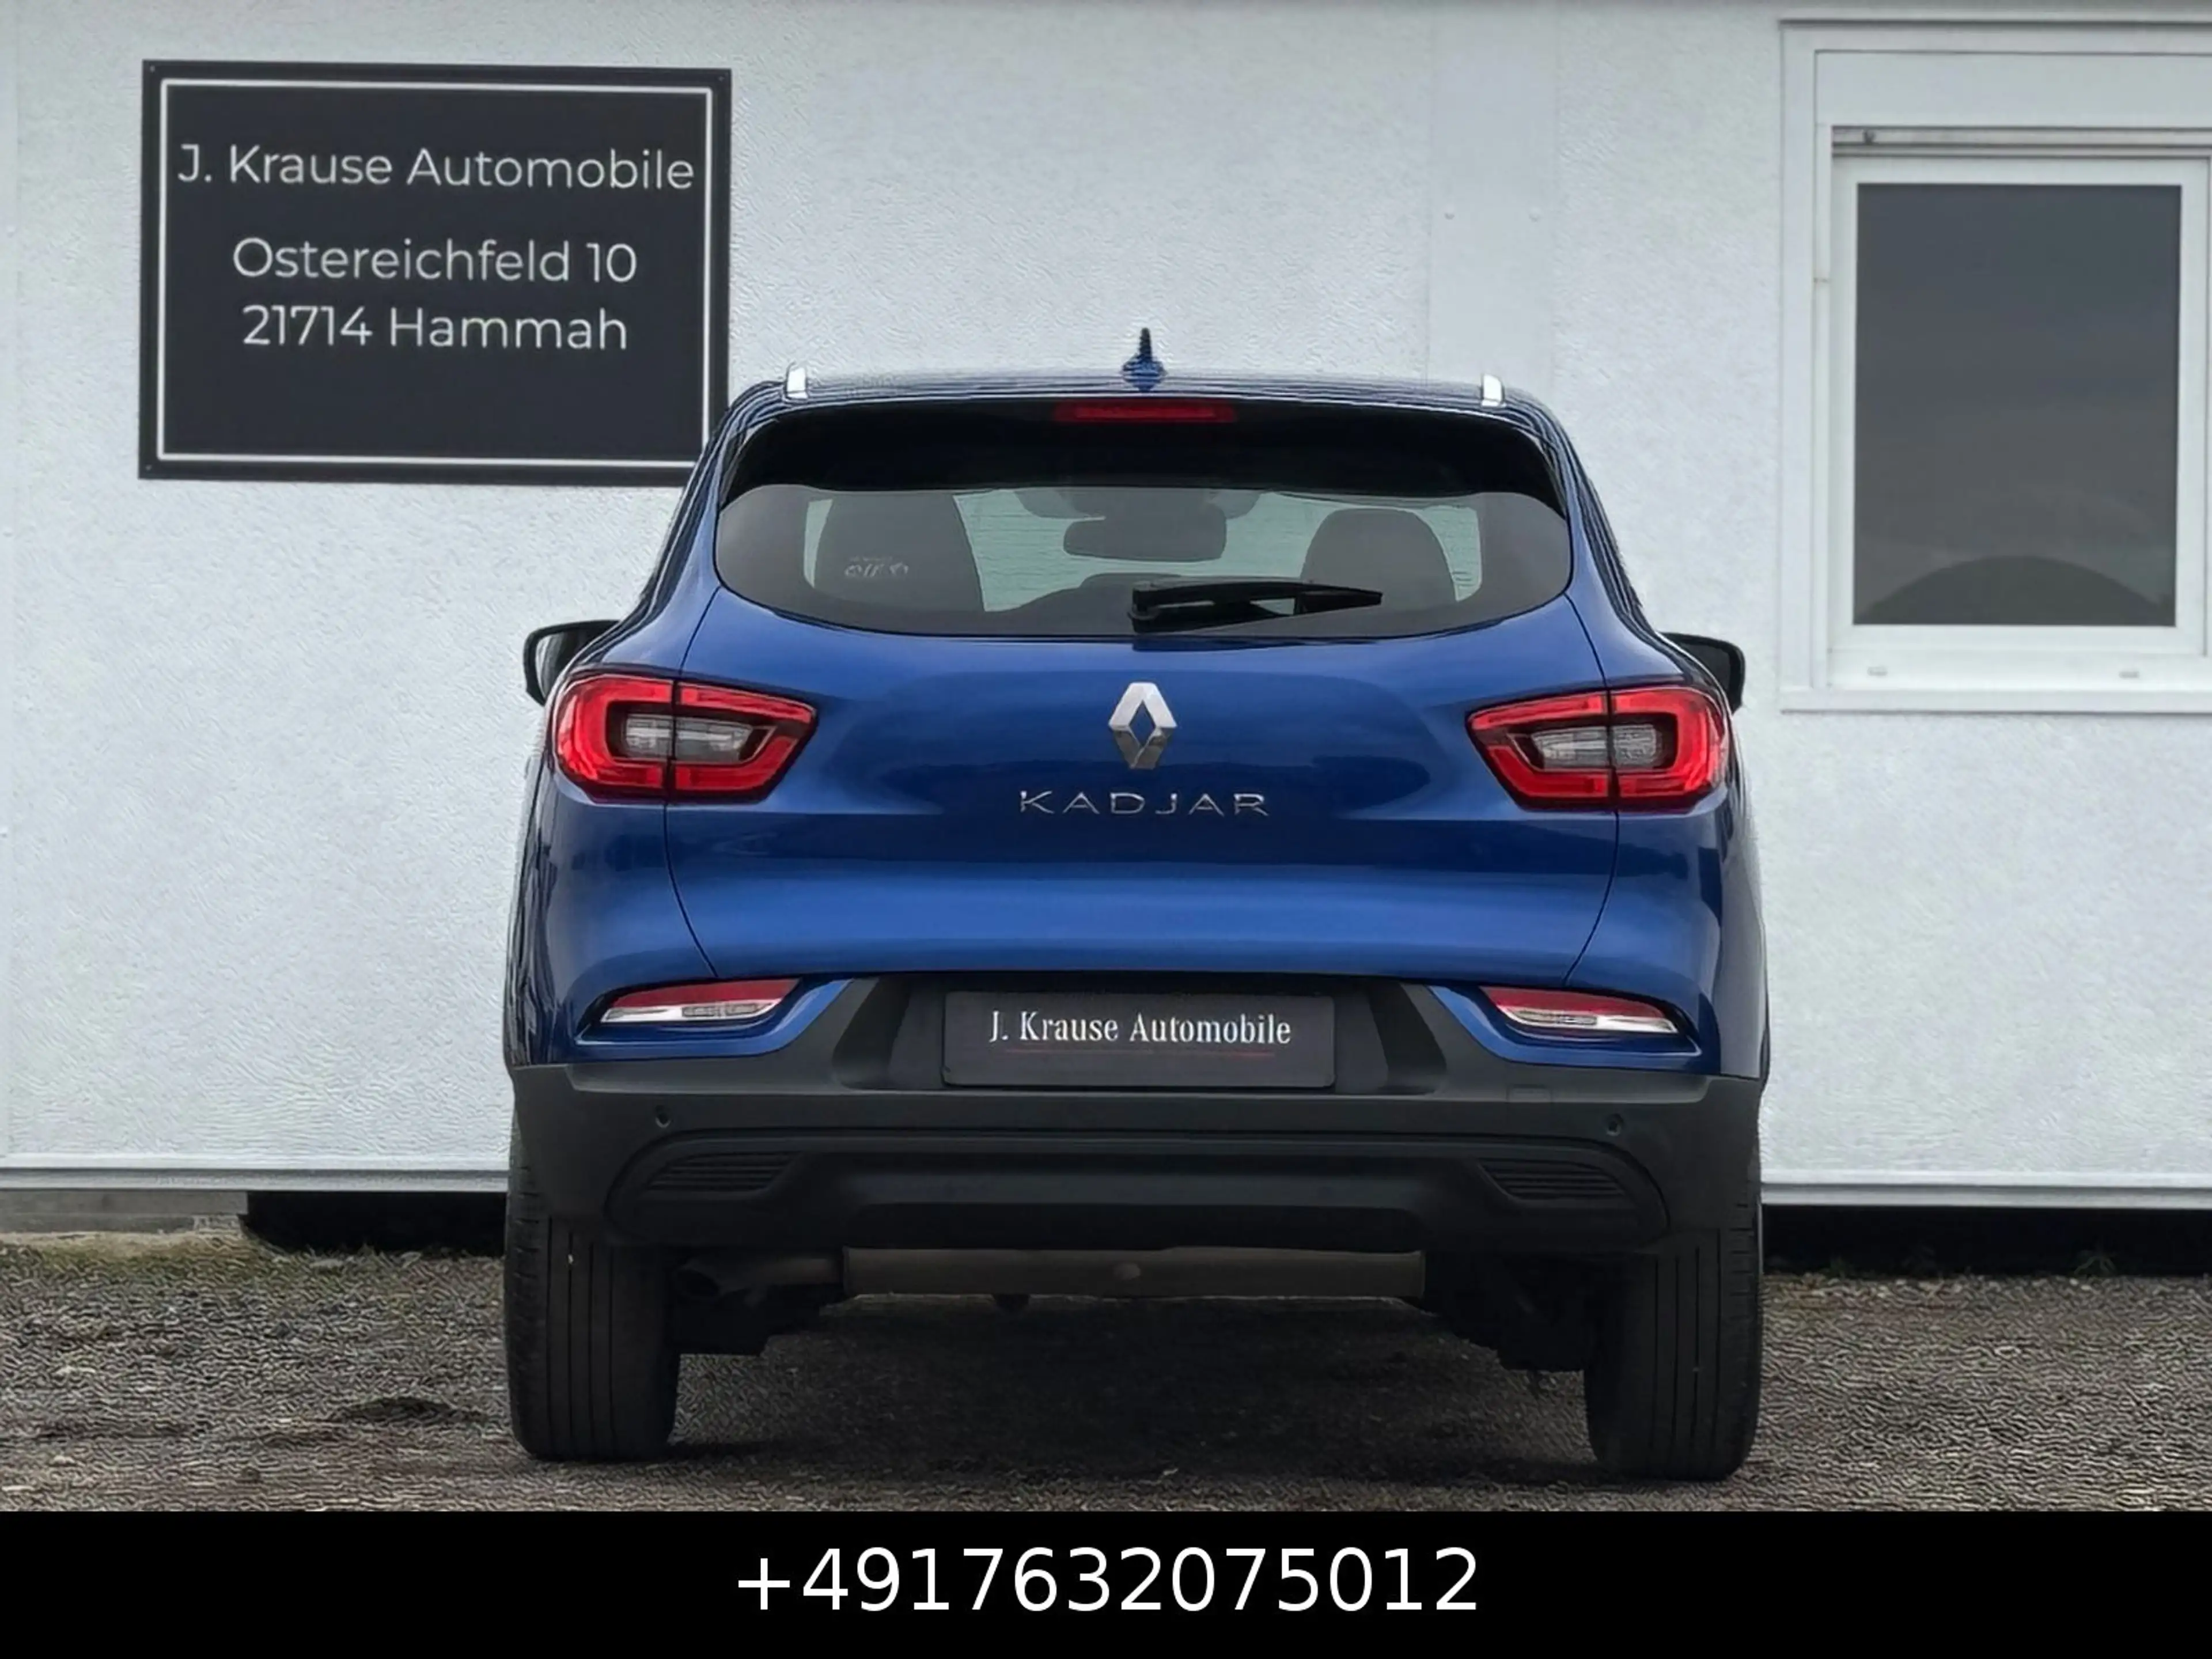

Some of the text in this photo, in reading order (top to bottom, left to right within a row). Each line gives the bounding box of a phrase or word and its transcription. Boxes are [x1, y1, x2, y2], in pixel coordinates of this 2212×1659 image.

[178, 143, 695, 190] J. Krause Automobile
[232, 236, 638, 283] Ostereichfeld 10
[243, 304, 627, 350] 21714 Hammah
[1019, 790, 1270, 817] KADJAR
[989, 1010, 1291, 1044] J. Krause Automobile
